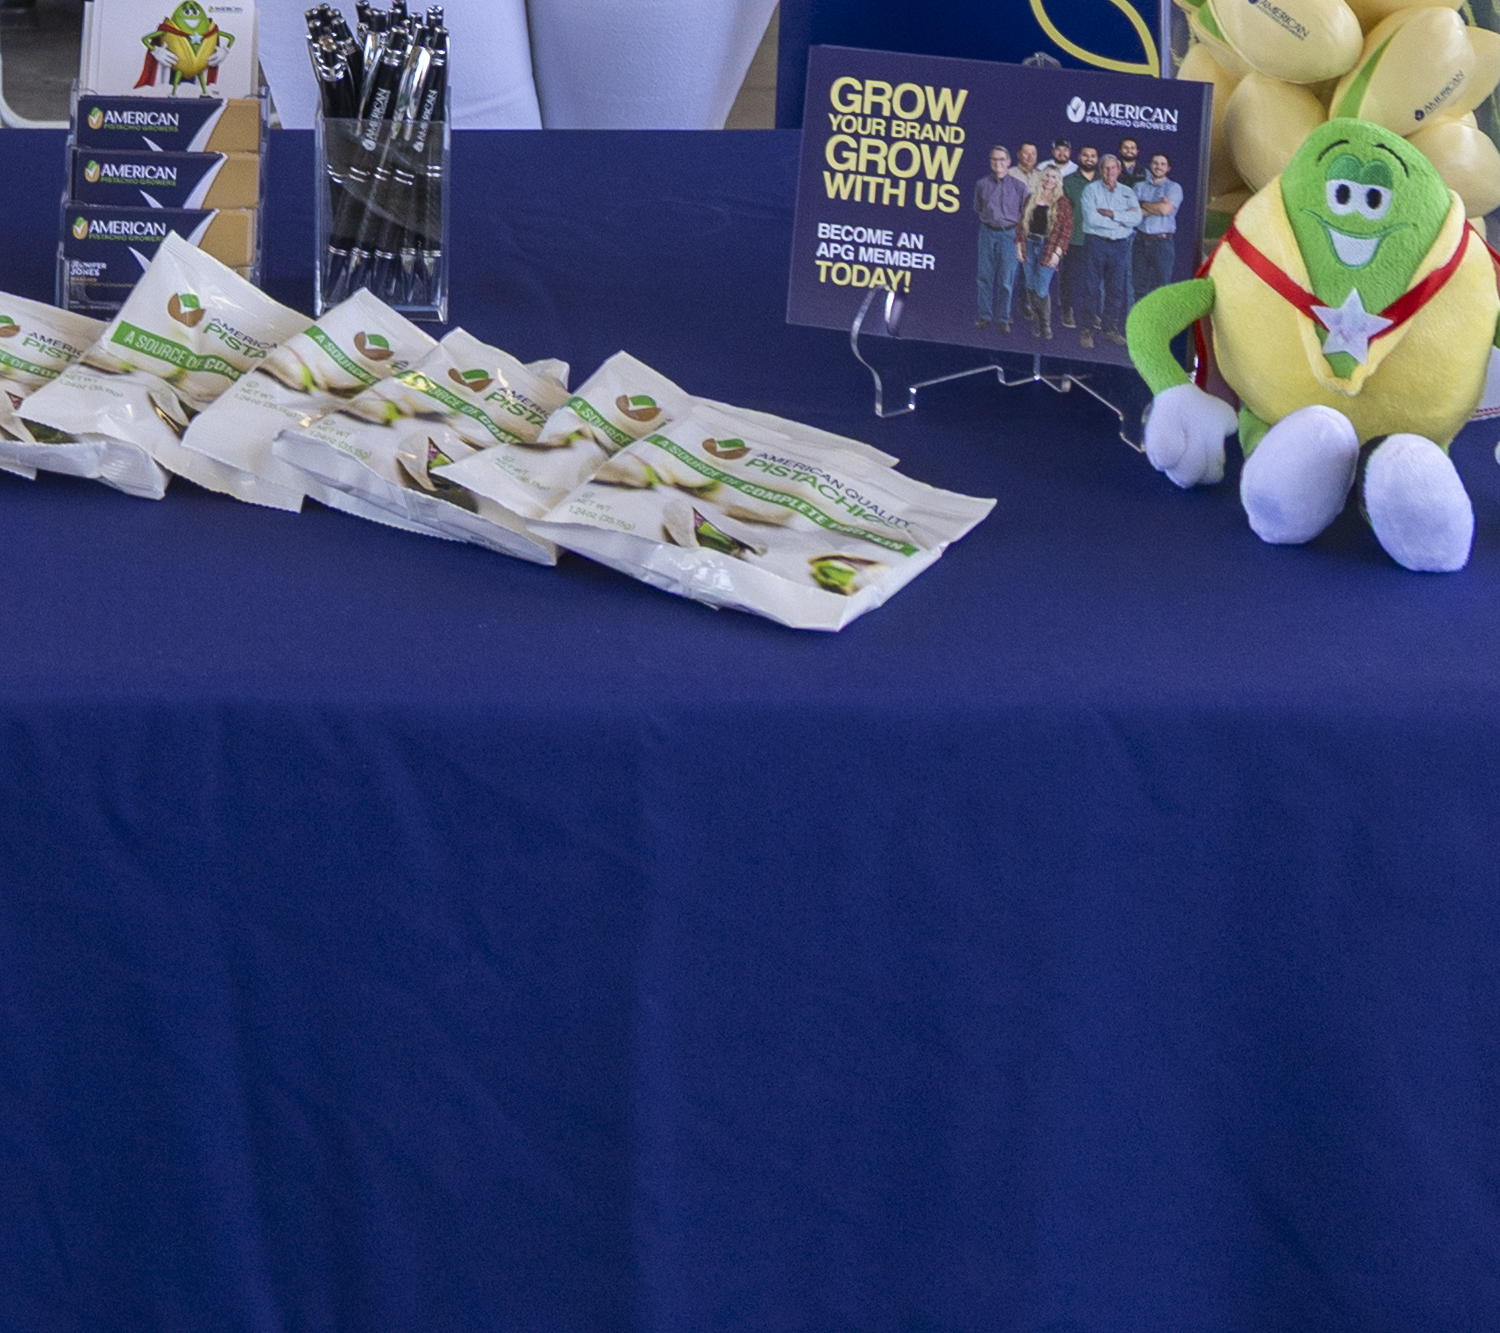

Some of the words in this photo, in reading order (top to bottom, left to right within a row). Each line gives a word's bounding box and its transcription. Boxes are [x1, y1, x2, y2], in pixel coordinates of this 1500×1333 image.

[830, 76, 968, 123] GROW
[1086, 101, 1178, 125] AMERICAN
[104, 110, 179, 126] AMERICAN
[828, 113, 886, 137] YOUR
[890, 120, 965, 145] BRAND
[100, 163, 177, 180] AMERICAN
[825, 134, 963, 182] GROW
[822, 171, 907, 207] WITH
[915, 182, 960, 213] US
[89, 220, 166, 236] AMERICAN
[816, 222, 894, 247] BECOME
[897, 232, 924, 250] AN
[815, 242, 854, 261] APG
[858, 247, 936, 270] MEMBER
[815, 259, 911, 293] TODAY!
[123, 331, 135, 344] A
[136, 334, 187, 365] SOURCE
[211, 317, 278, 350] AMERICA
[315, 333, 324, 343] A
[572, 401, 581, 410] A
[660, 440, 668, 449] A
[670, 446, 720, 480] SOURCE
[740, 485, 827, 524] COMPLETE
[755, 452, 844, 489] AMERICAN
[844, 487, 917, 528] QUALITY
